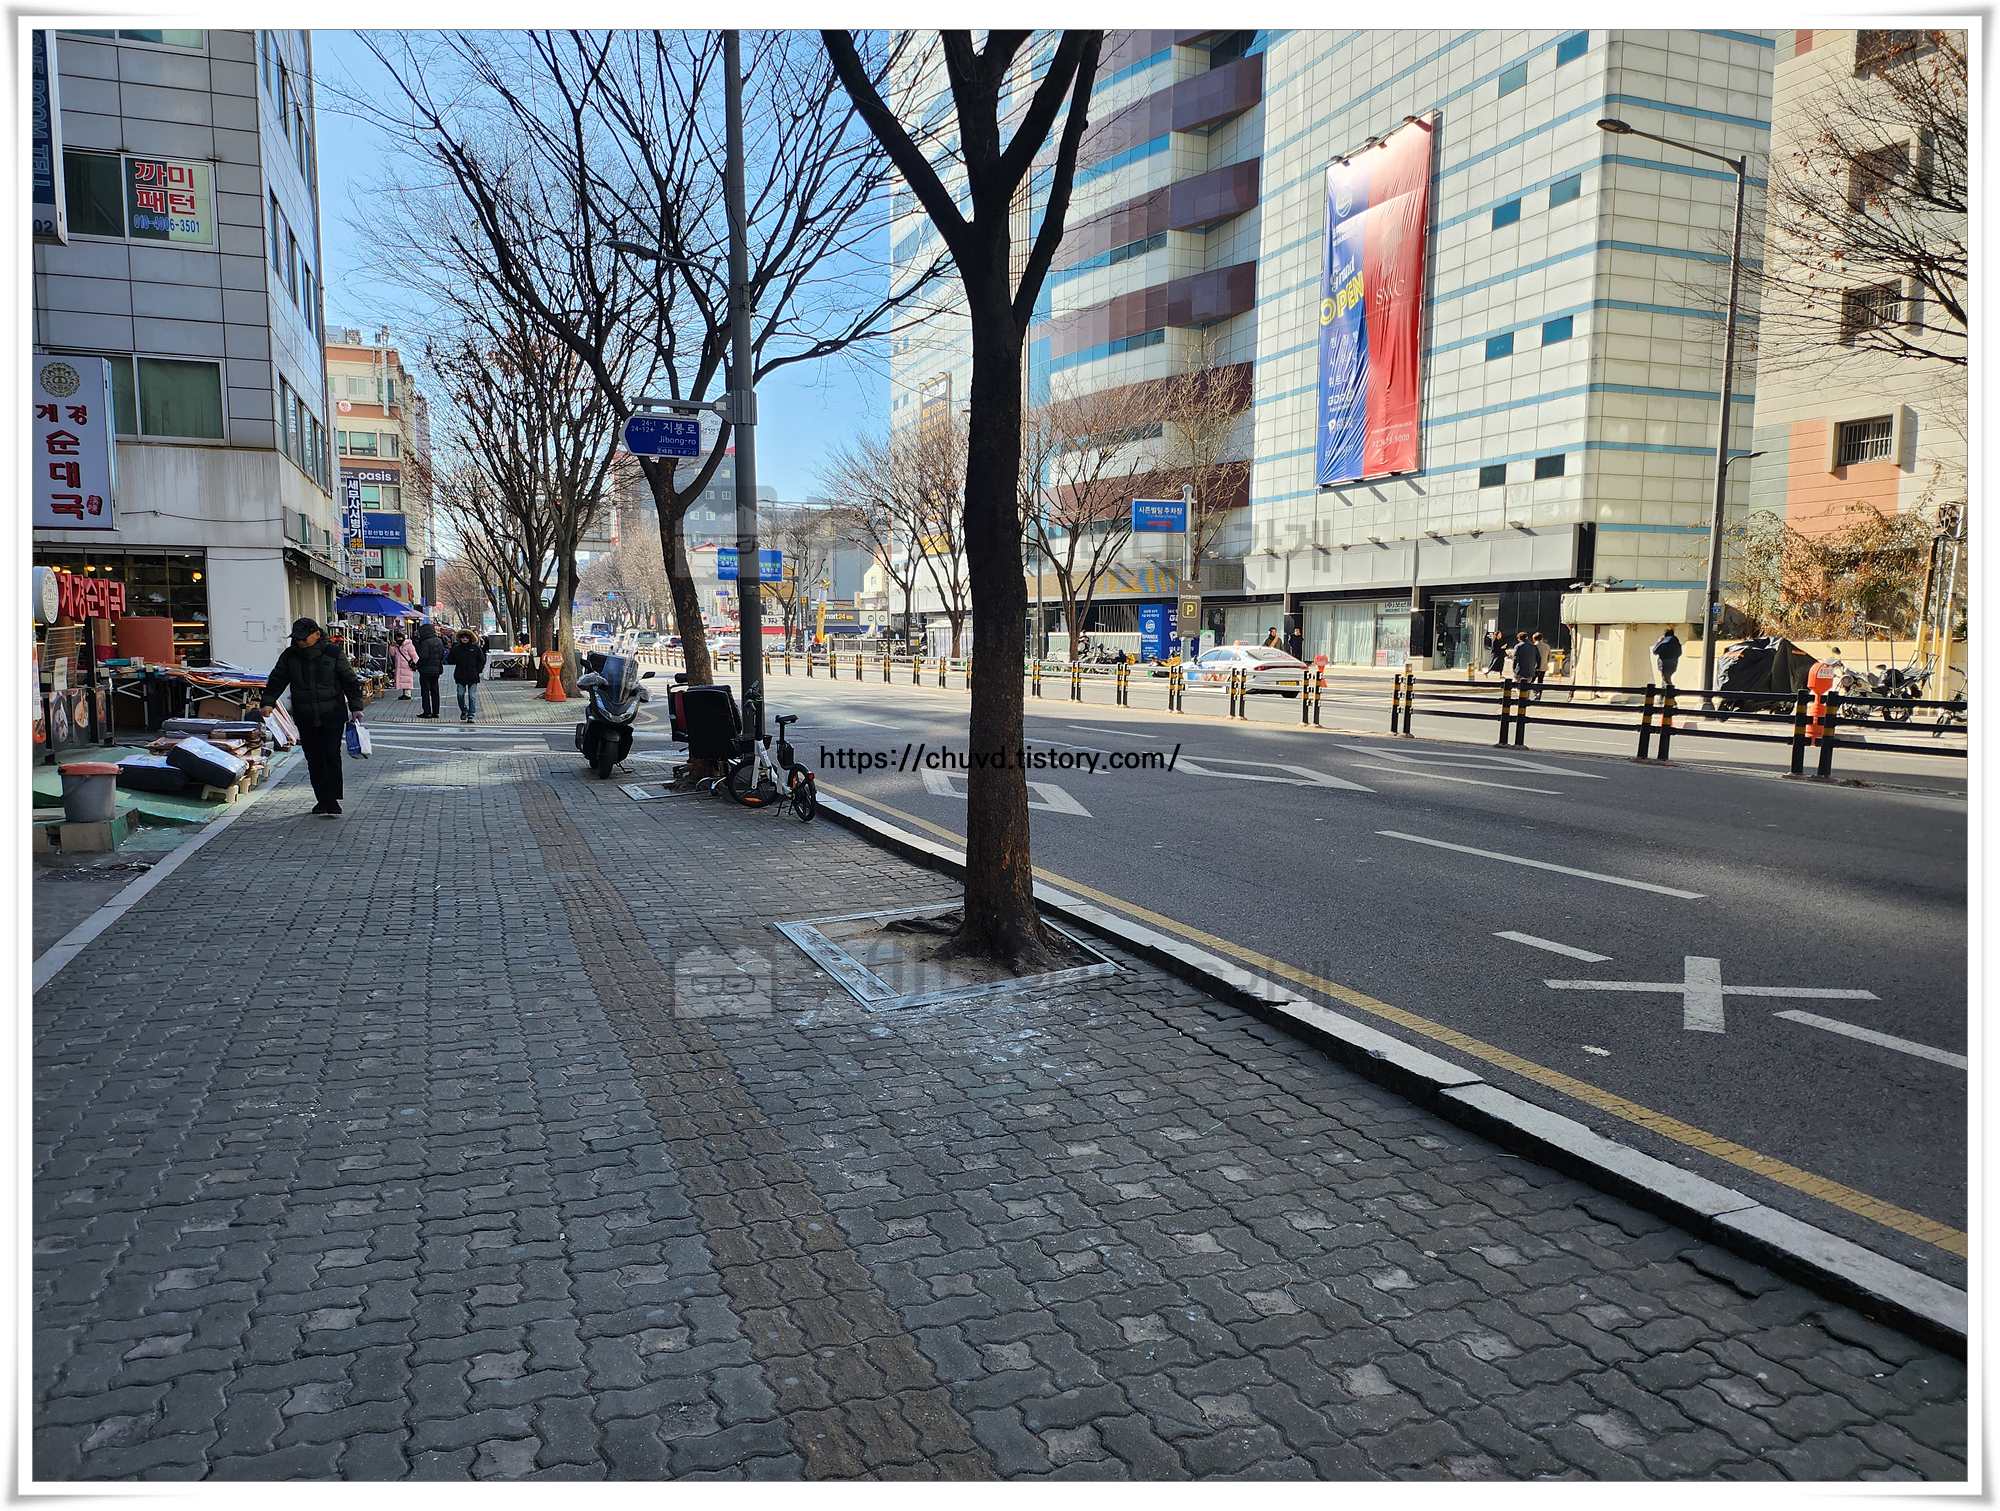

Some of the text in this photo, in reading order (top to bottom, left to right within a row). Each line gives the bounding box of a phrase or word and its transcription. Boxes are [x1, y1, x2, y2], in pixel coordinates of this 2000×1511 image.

[135, 161, 194, 189] 까미
[137, 190, 196, 215] 패턴
[1320, 271, 1364, 325] OPEN
[36, 404, 87, 425] 계경
[662, 421, 697, 435] 지봉로
[659, 435, 697, 446] Jibong-ro
[358, 470, 392, 481] oasis
